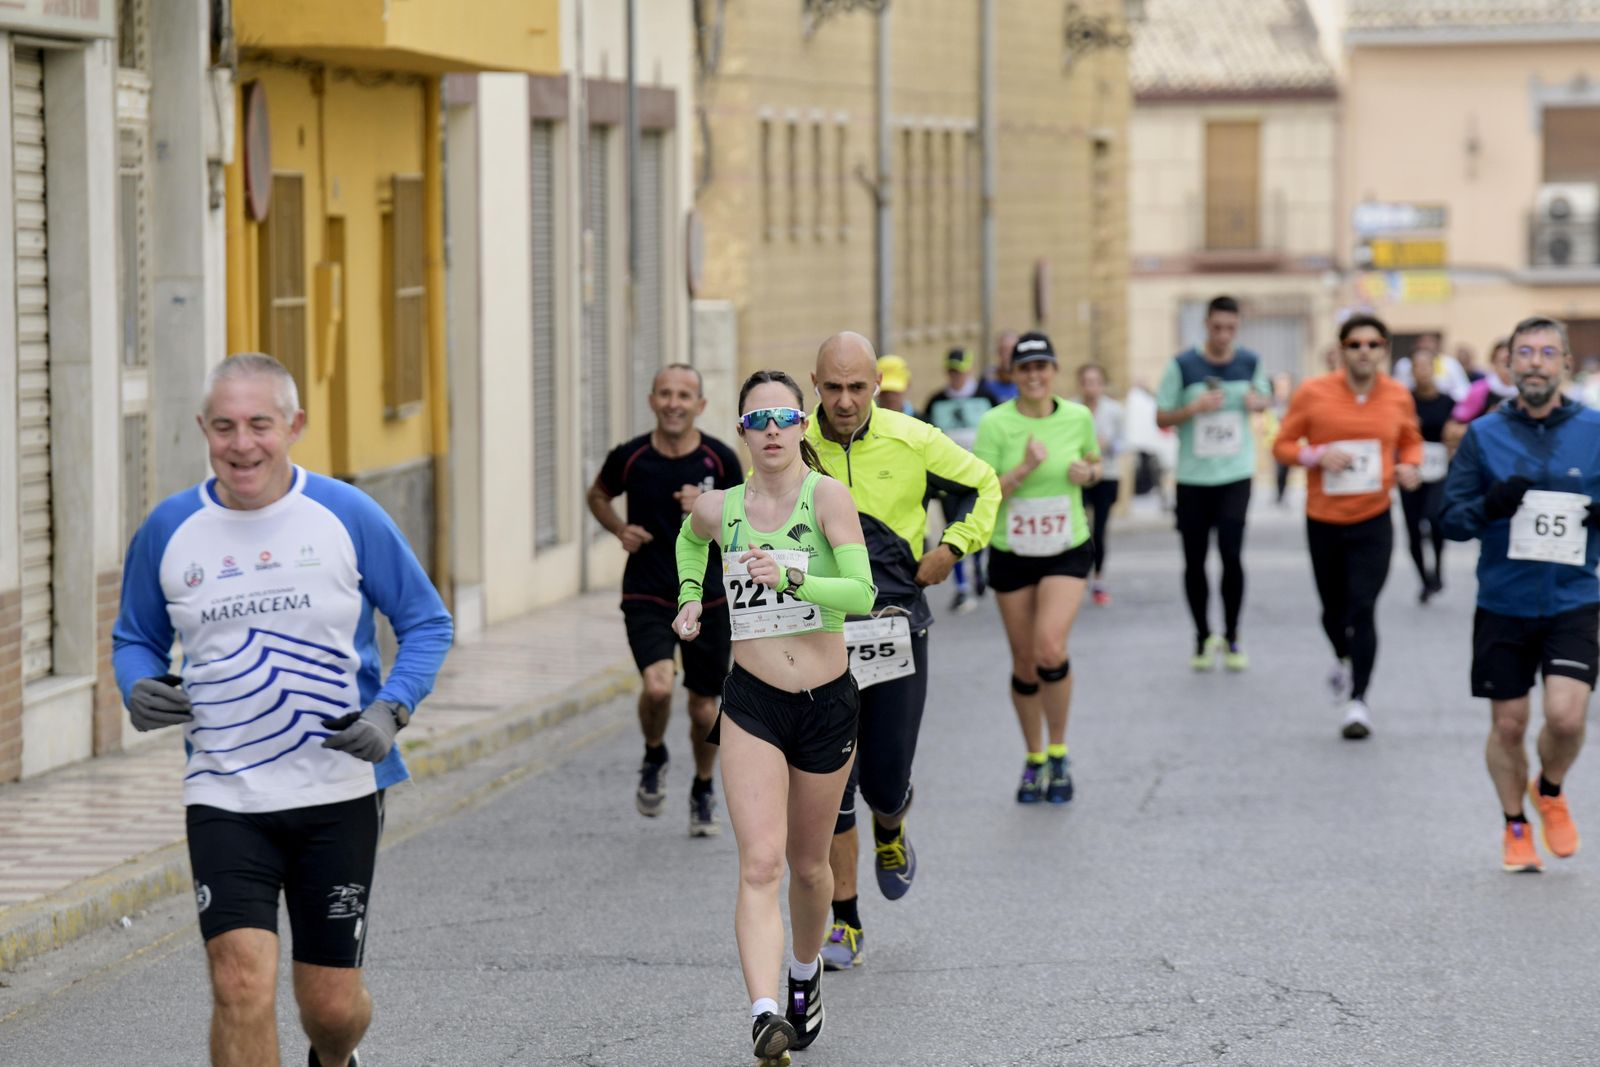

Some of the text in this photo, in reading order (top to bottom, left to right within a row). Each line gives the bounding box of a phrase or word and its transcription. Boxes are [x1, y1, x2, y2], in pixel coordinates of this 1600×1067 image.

[1012, 513, 1066, 536] 2157
[1535, 514, 1566, 537] 65
[200, 593, 312, 624] MARACENA
